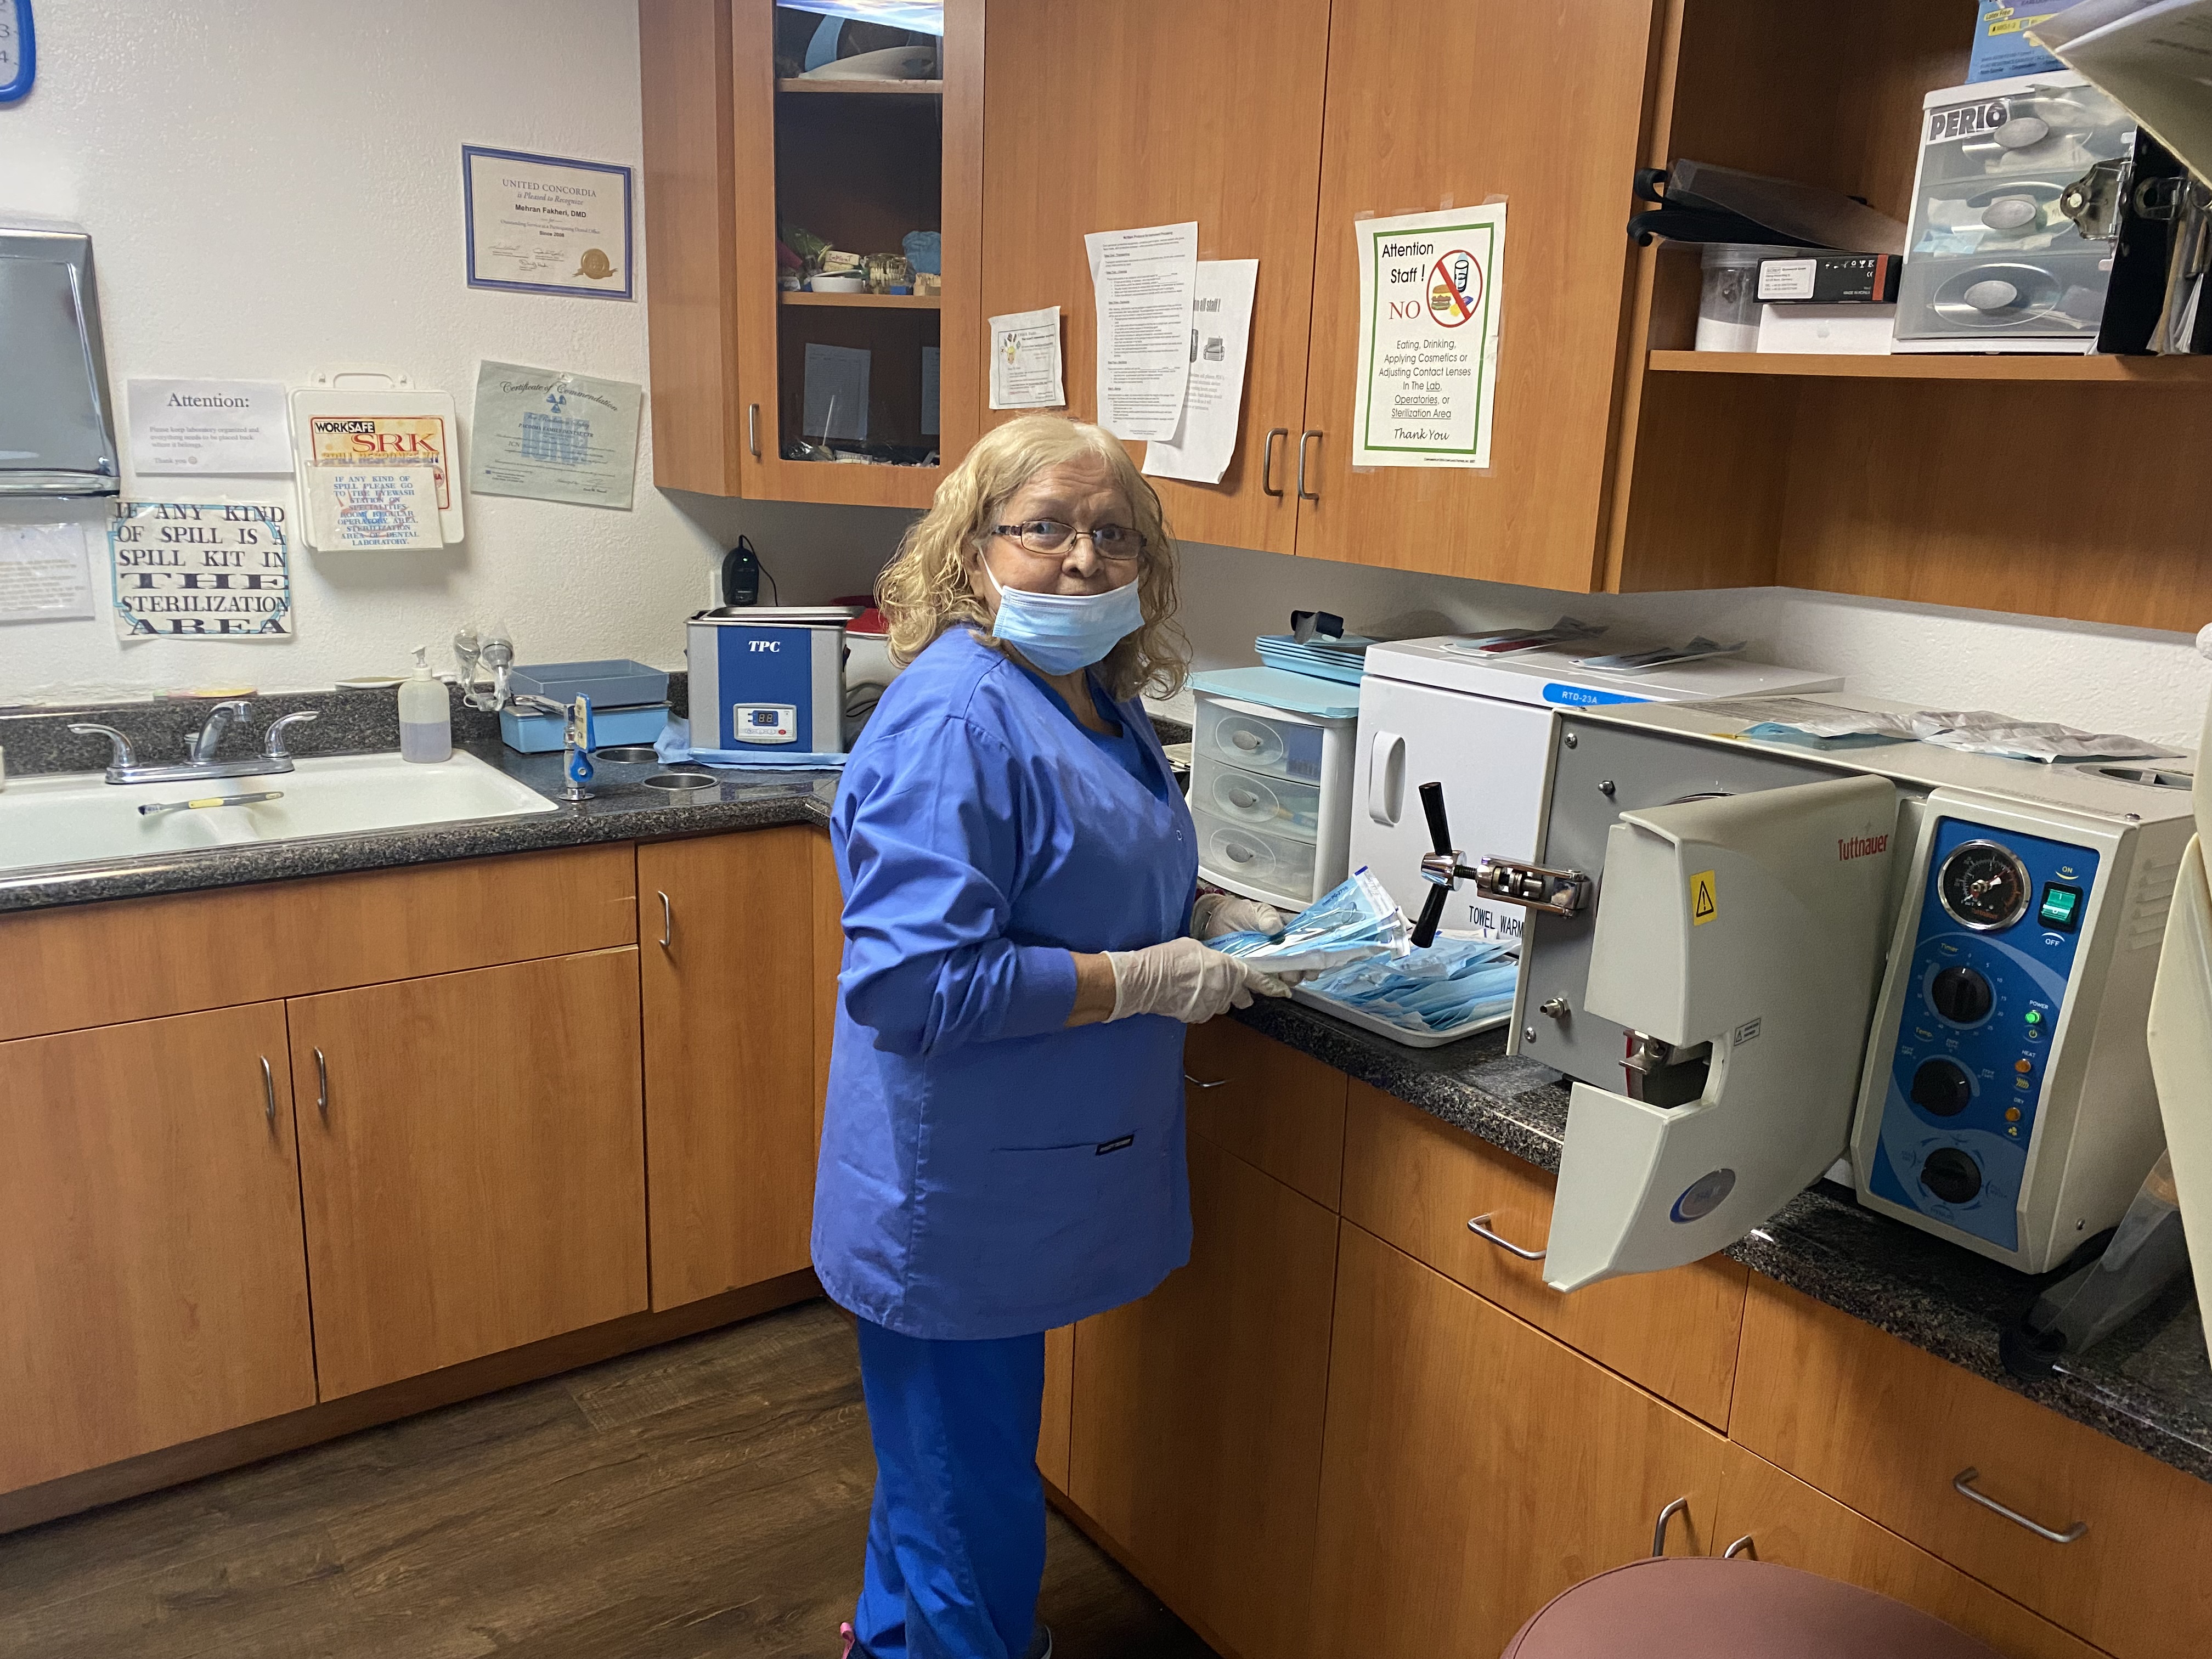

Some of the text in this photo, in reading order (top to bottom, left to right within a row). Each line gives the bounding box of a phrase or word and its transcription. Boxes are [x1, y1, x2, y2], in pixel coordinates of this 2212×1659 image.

[1929, 102, 2007, 142] PERIO
[503, 179, 596, 197] UNITED CONCORDIA
[524, 192, 546, 201] Pleased
[555, 196, 583, 205] Recognize
[515, 204, 540, 213] Mehran
[543, 207, 569, 217] Fakheri,
[1382, 242, 1434, 258] Attention
[1391, 267, 1417, 283] Staff
[1389, 300, 1421, 320] NO
[1397, 339, 1457, 351] Eating, Drinking,
[1384, 353, 1468, 365] Applying Cosmetics or
[1379, 367, 1471, 379] Adjusting Contact Lenses
[1403, 381, 1442, 391] In The Lab,
[167, 393, 250, 408] Attention:
[500, 381, 618, 411] Certificate of Commendation
[1395, 394, 1449, 405] Operatories, or
[1391, 408, 1451, 419] Sterilization Area
[315, 422, 374, 433] WORKSAFE
[1394, 428, 1449, 440] Thank You
[351, 433, 439, 452] SRK
[115, 503, 284, 522] IF ANY KIND
[117, 526, 286, 545] OF SPILL IS A
[119, 549, 286, 567] SPILL KIT IN
[120, 573, 288, 590] THE
[121, 596, 289, 612] STERILIZATION
[127, 618, 291, 635] AREA
[748, 641, 781, 652] TPC
[1562, 691, 1597, 704] RTD-23A
[1838, 834, 1888, 861] Tuttnauer
[1469, 905, 1495, 929] TOWEL
[1941, 943, 1959, 952] Timer
[2045, 938, 2060, 946] OFF
[2029, 1000, 2049, 1010] POWER
[2022, 1049, 2036, 1058] HEAT
